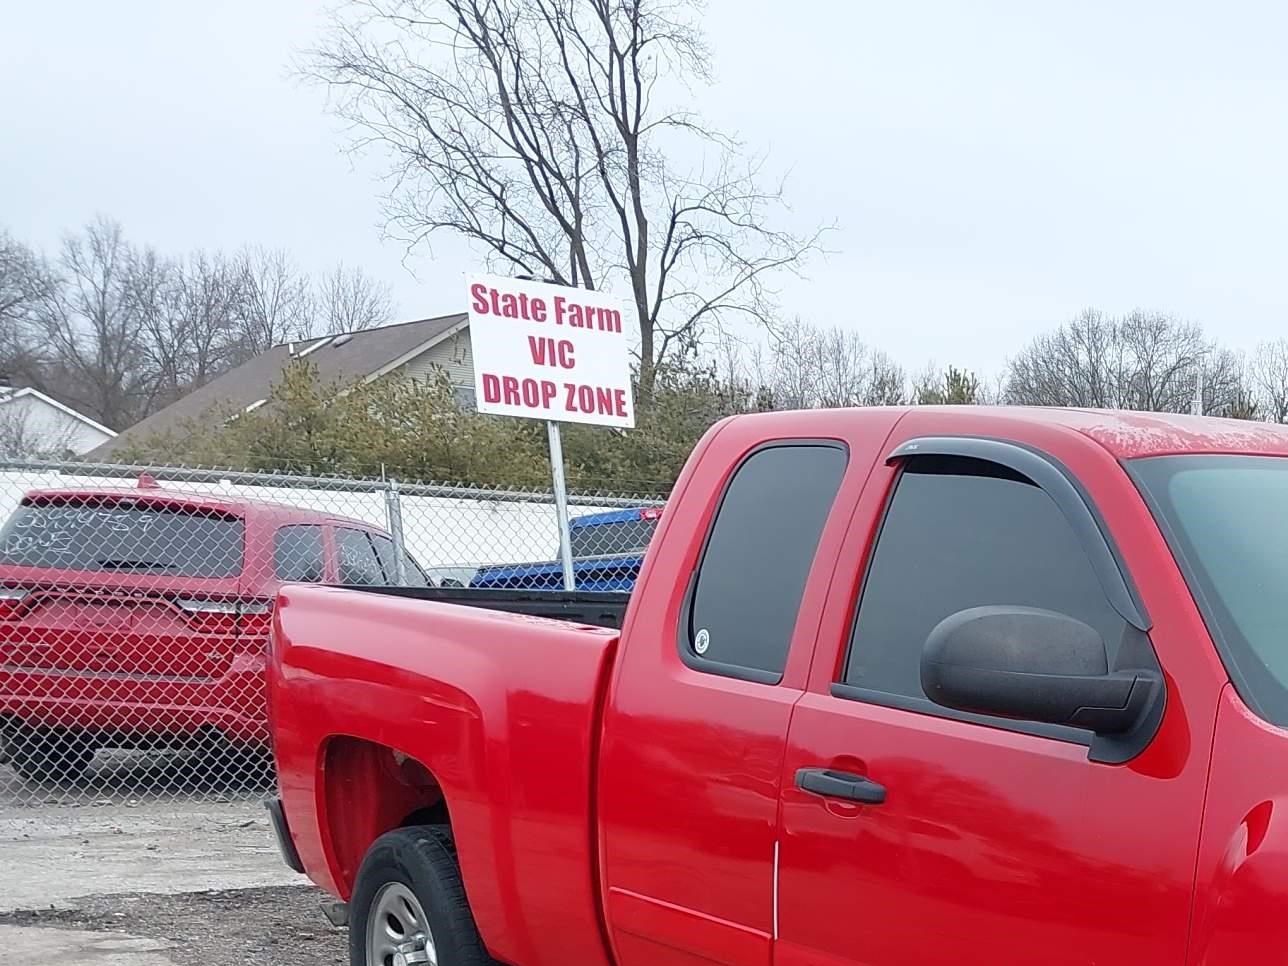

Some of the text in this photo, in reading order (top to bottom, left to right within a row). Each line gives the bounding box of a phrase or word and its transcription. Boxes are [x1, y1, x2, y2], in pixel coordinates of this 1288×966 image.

[471, 283, 622, 333] State Farm
[528, 335, 576, 369] VIC
[482, 373, 628, 417] DROP ZONE
